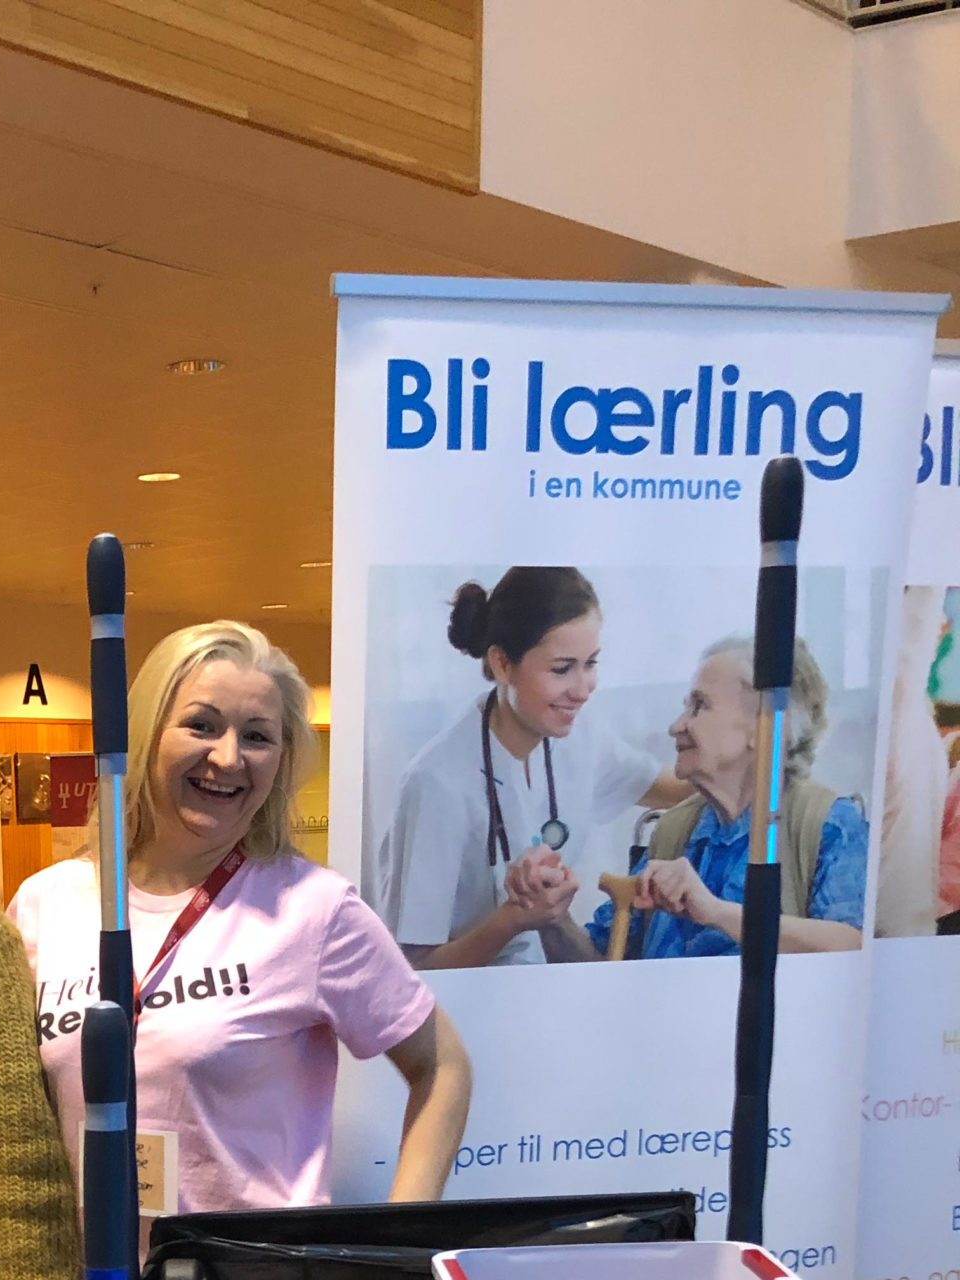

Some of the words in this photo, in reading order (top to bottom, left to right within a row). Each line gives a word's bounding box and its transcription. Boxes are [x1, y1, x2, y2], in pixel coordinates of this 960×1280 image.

[387, 358, 490, 451] Bli
[526, 361, 863, 481] lærling
[529, 469, 536, 497] i
[545, 476, 582, 498] en
[592, 471, 742, 500] kommune
[22, 663, 48, 706] A
[36, 967, 101, 1011] Hei
[36, 963, 251, 1046] Reold!!
[517, 1134, 541, 1163] til
[552, 1126, 628, 1161] med
[637, 1127, 793, 1158] lærepss
